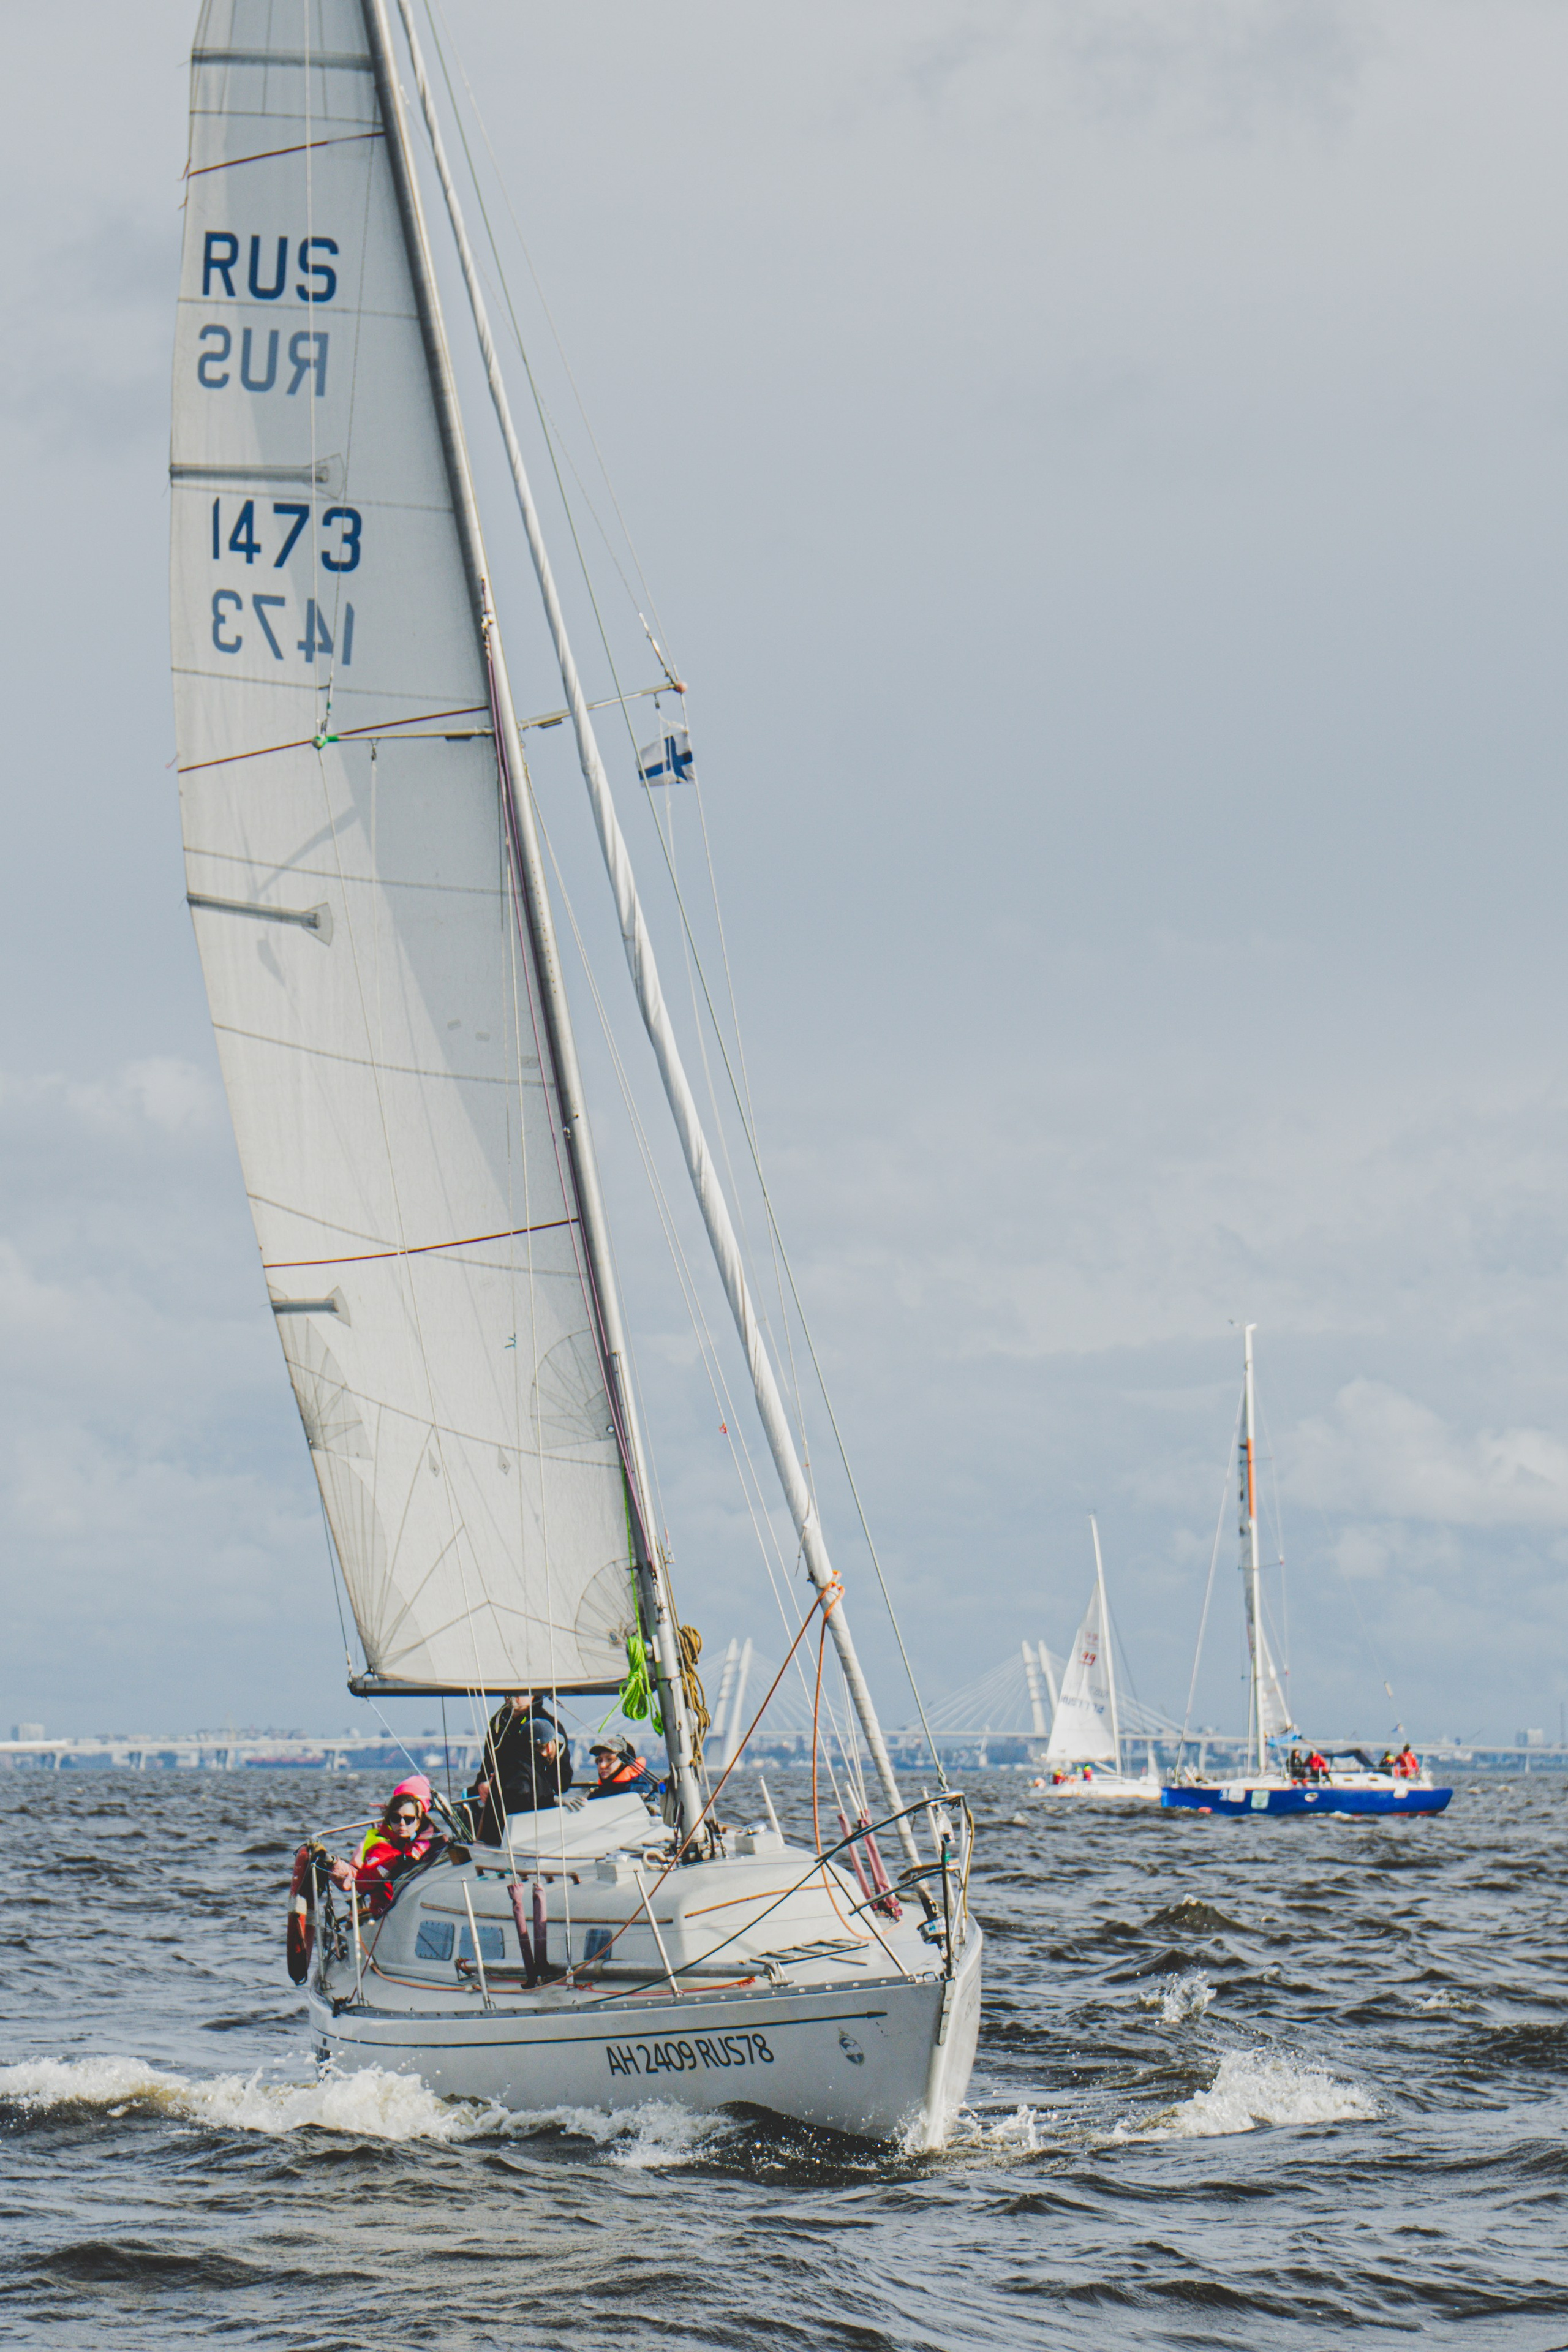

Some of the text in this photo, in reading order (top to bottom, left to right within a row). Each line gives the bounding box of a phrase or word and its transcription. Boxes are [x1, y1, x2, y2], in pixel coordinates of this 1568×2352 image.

[203, 230, 339, 303] RUS
[213, 497, 362, 572] 1473
[606, 2034, 774, 2075] AH 2409 RUS78
